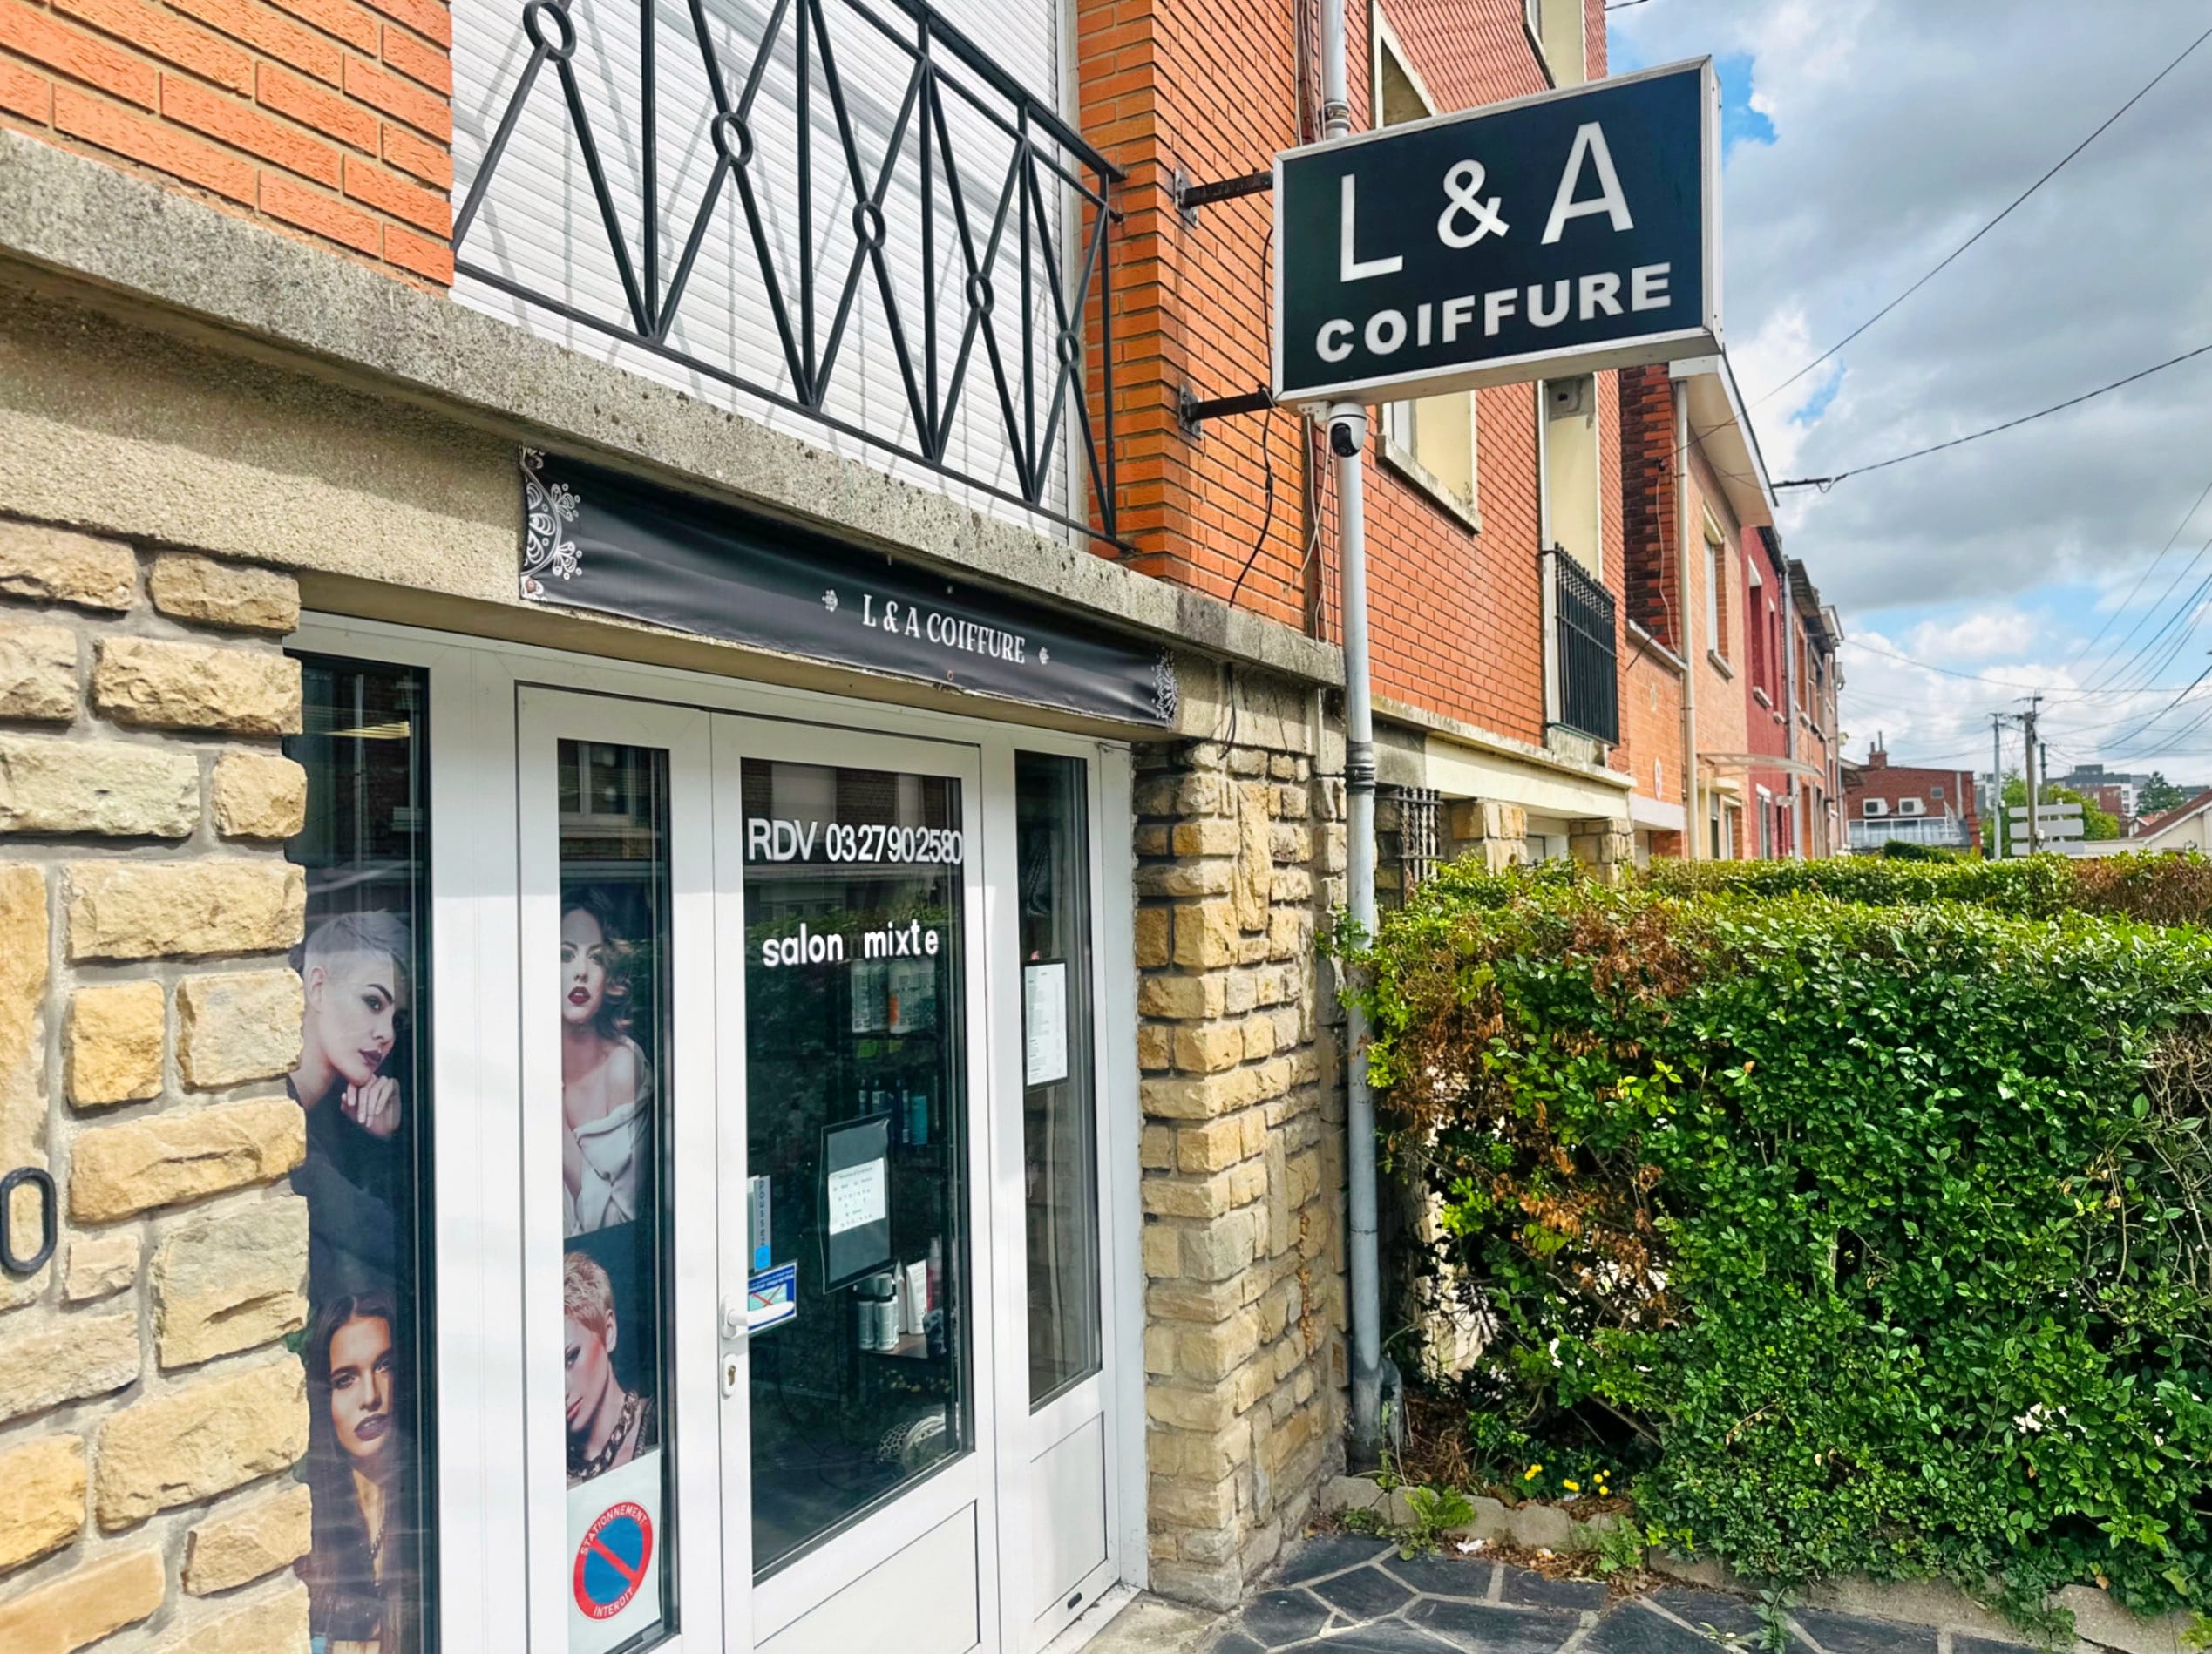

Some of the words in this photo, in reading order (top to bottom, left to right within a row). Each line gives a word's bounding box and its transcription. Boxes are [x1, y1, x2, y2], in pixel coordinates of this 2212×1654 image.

[1340, 173, 1404, 283] L
[1436, 159, 1510, 250] &
[1539, 120, 1635, 245] A
[1315, 261, 1672, 363] COIFFURE
[862, 594, 877, 628] L
[883, 600, 899, 634] &
[904, 606, 921, 639] A
[926, 613, 1026, 664] COIFFURE
[747, 817, 818, 862] RDV
[762, 922, 844, 967] salon
[864, 919, 940, 959] mixte
[580, 1504, 648, 1556] STATIONNEMENT
[593, 1586, 634, 1617] INTERDIT
